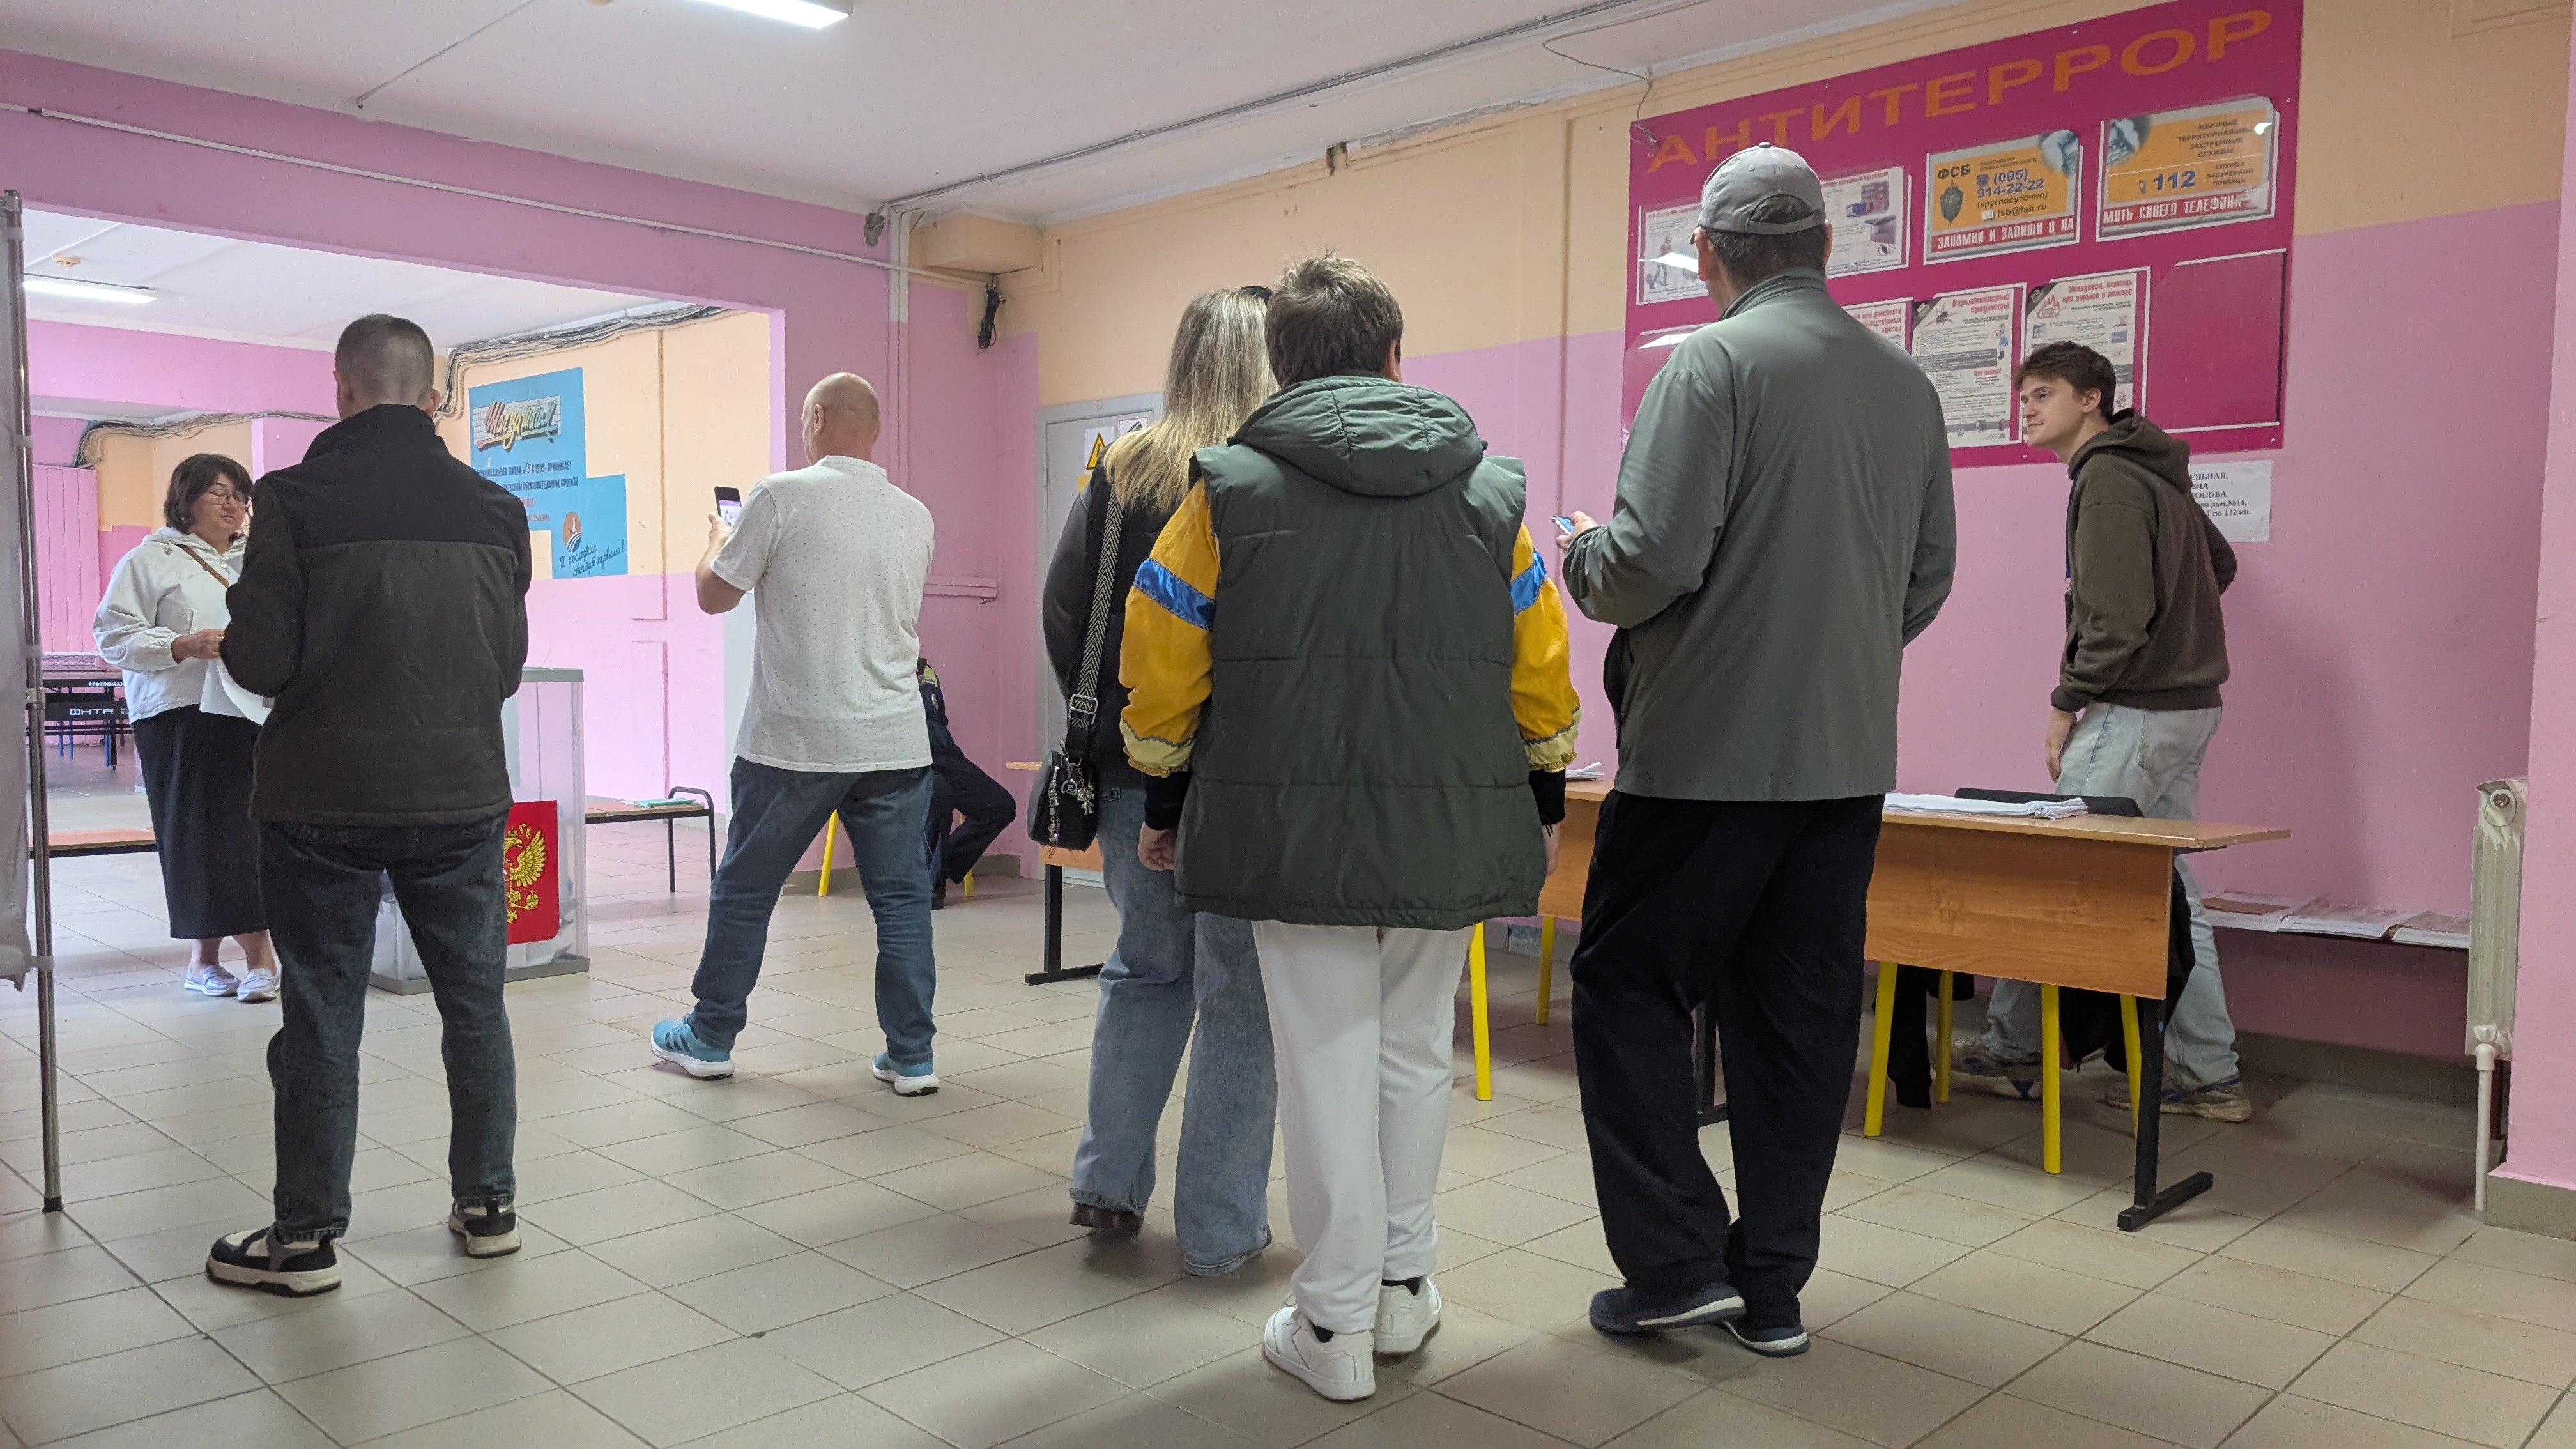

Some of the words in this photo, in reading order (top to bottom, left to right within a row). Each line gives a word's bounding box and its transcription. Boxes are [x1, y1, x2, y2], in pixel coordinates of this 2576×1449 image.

[1648, 8, 2273, 174] АНТИТЕРРОР
[2198, 119, 2238, 130] МЕСТНЫЕ
[2177, 127, 2257, 142] ТЕРРИТОРИАЛЬНЫ
[2198, 148, 2234, 157] СЛУЖБЫ
[1938, 164, 1970, 180] ФСБ
[1993, 169, 2028, 185] (095)
[1977, 178, 2044, 198] 914-22-22
[2153, 170, 2196, 191] 112
[1977, 191, 2048, 210] (круглосуточно)
[1997, 204, 2047, 217] fsb@fsb.ru
[2103, 209, 2133, 224] МЯТЬ
[2140, 203, 2177, 220] СВОЕГО
[1938, 232, 1984, 249] ЗАПОМНИ
[1989, 231, 1995, 241] И
[2001, 222, 2043, 240] ЗАПИШИ
[2048, 220, 2055, 233] В
[2061, 218, 2074, 231] ПА
[2191, 472, 2228, 480] ЕЛЬНАЯ,
[2193, 491, 2227, 499] ОСОВА
